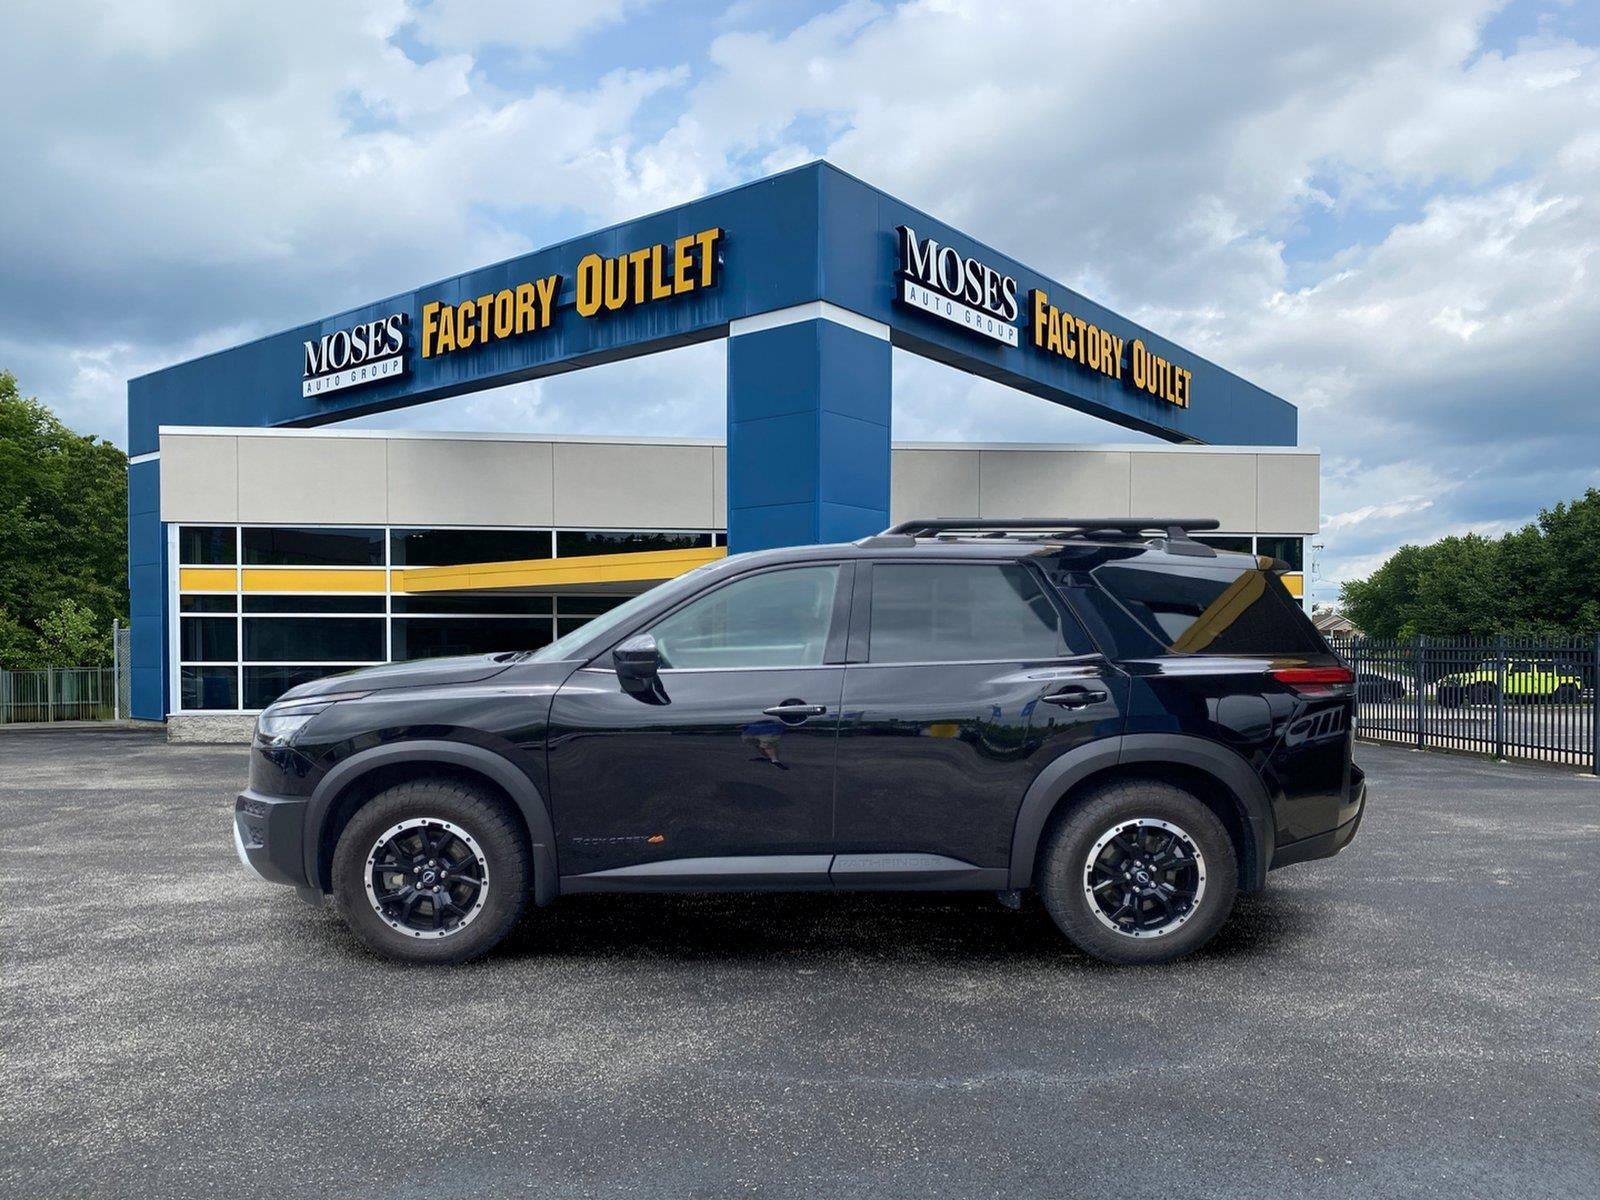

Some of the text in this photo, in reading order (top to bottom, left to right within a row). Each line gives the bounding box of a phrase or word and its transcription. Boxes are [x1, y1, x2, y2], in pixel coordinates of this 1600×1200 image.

[421, 227, 719, 358] FACTORY OUTLET
[903, 225, 1018, 322] MOSES
[910, 286, 1014, 340] AUTO GROUP
[302, 313, 403, 377] MOSES
[306, 360, 399, 393] AUTO GROUP
[1035, 289, 1192, 408] FACTORY OUTLET
